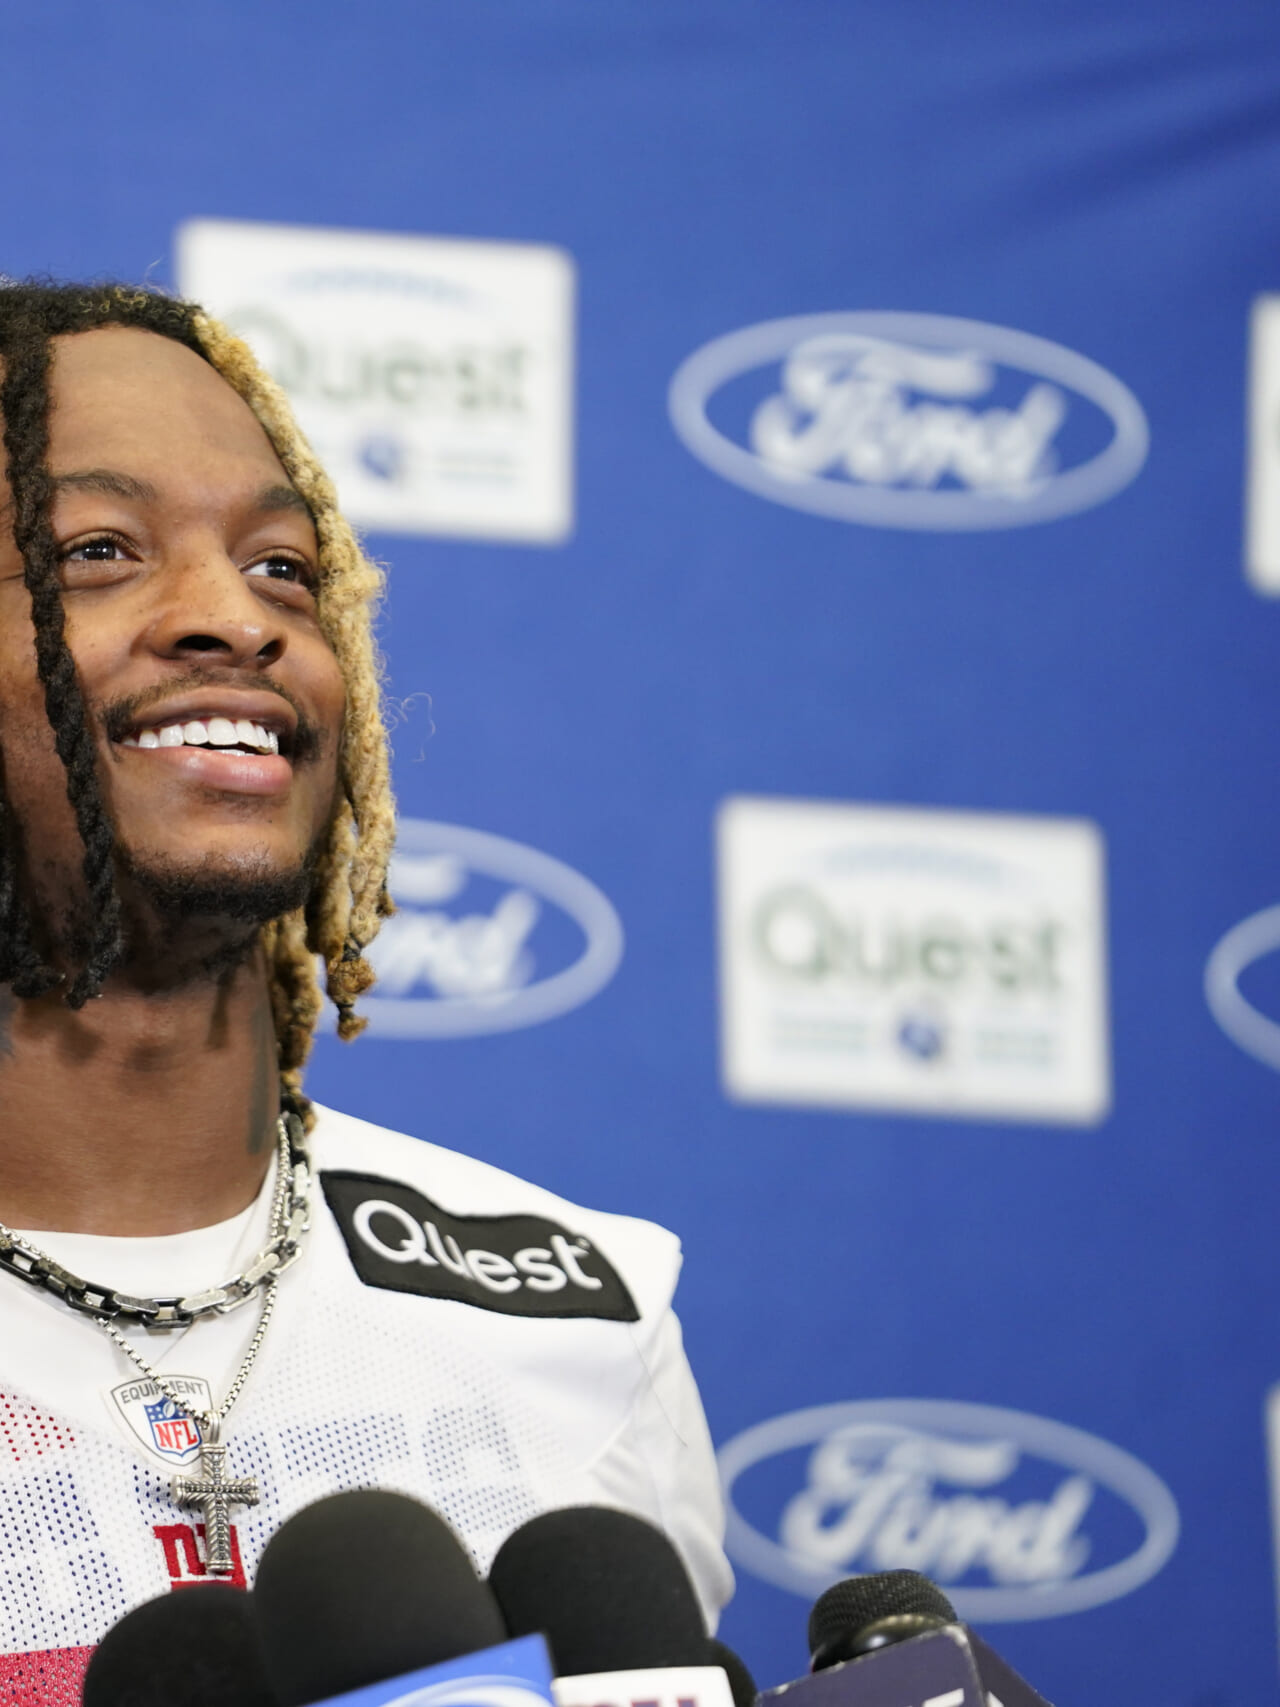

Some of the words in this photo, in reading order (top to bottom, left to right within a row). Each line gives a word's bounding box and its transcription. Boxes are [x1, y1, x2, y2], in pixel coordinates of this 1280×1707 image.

[749, 333, 1065, 500] Ford
[752, 881, 1068, 994] Quest
[353, 1199, 603, 1293] Quest
[154, 1420, 199, 1450] NFL
[779, 1424, 1095, 1586] Ford
